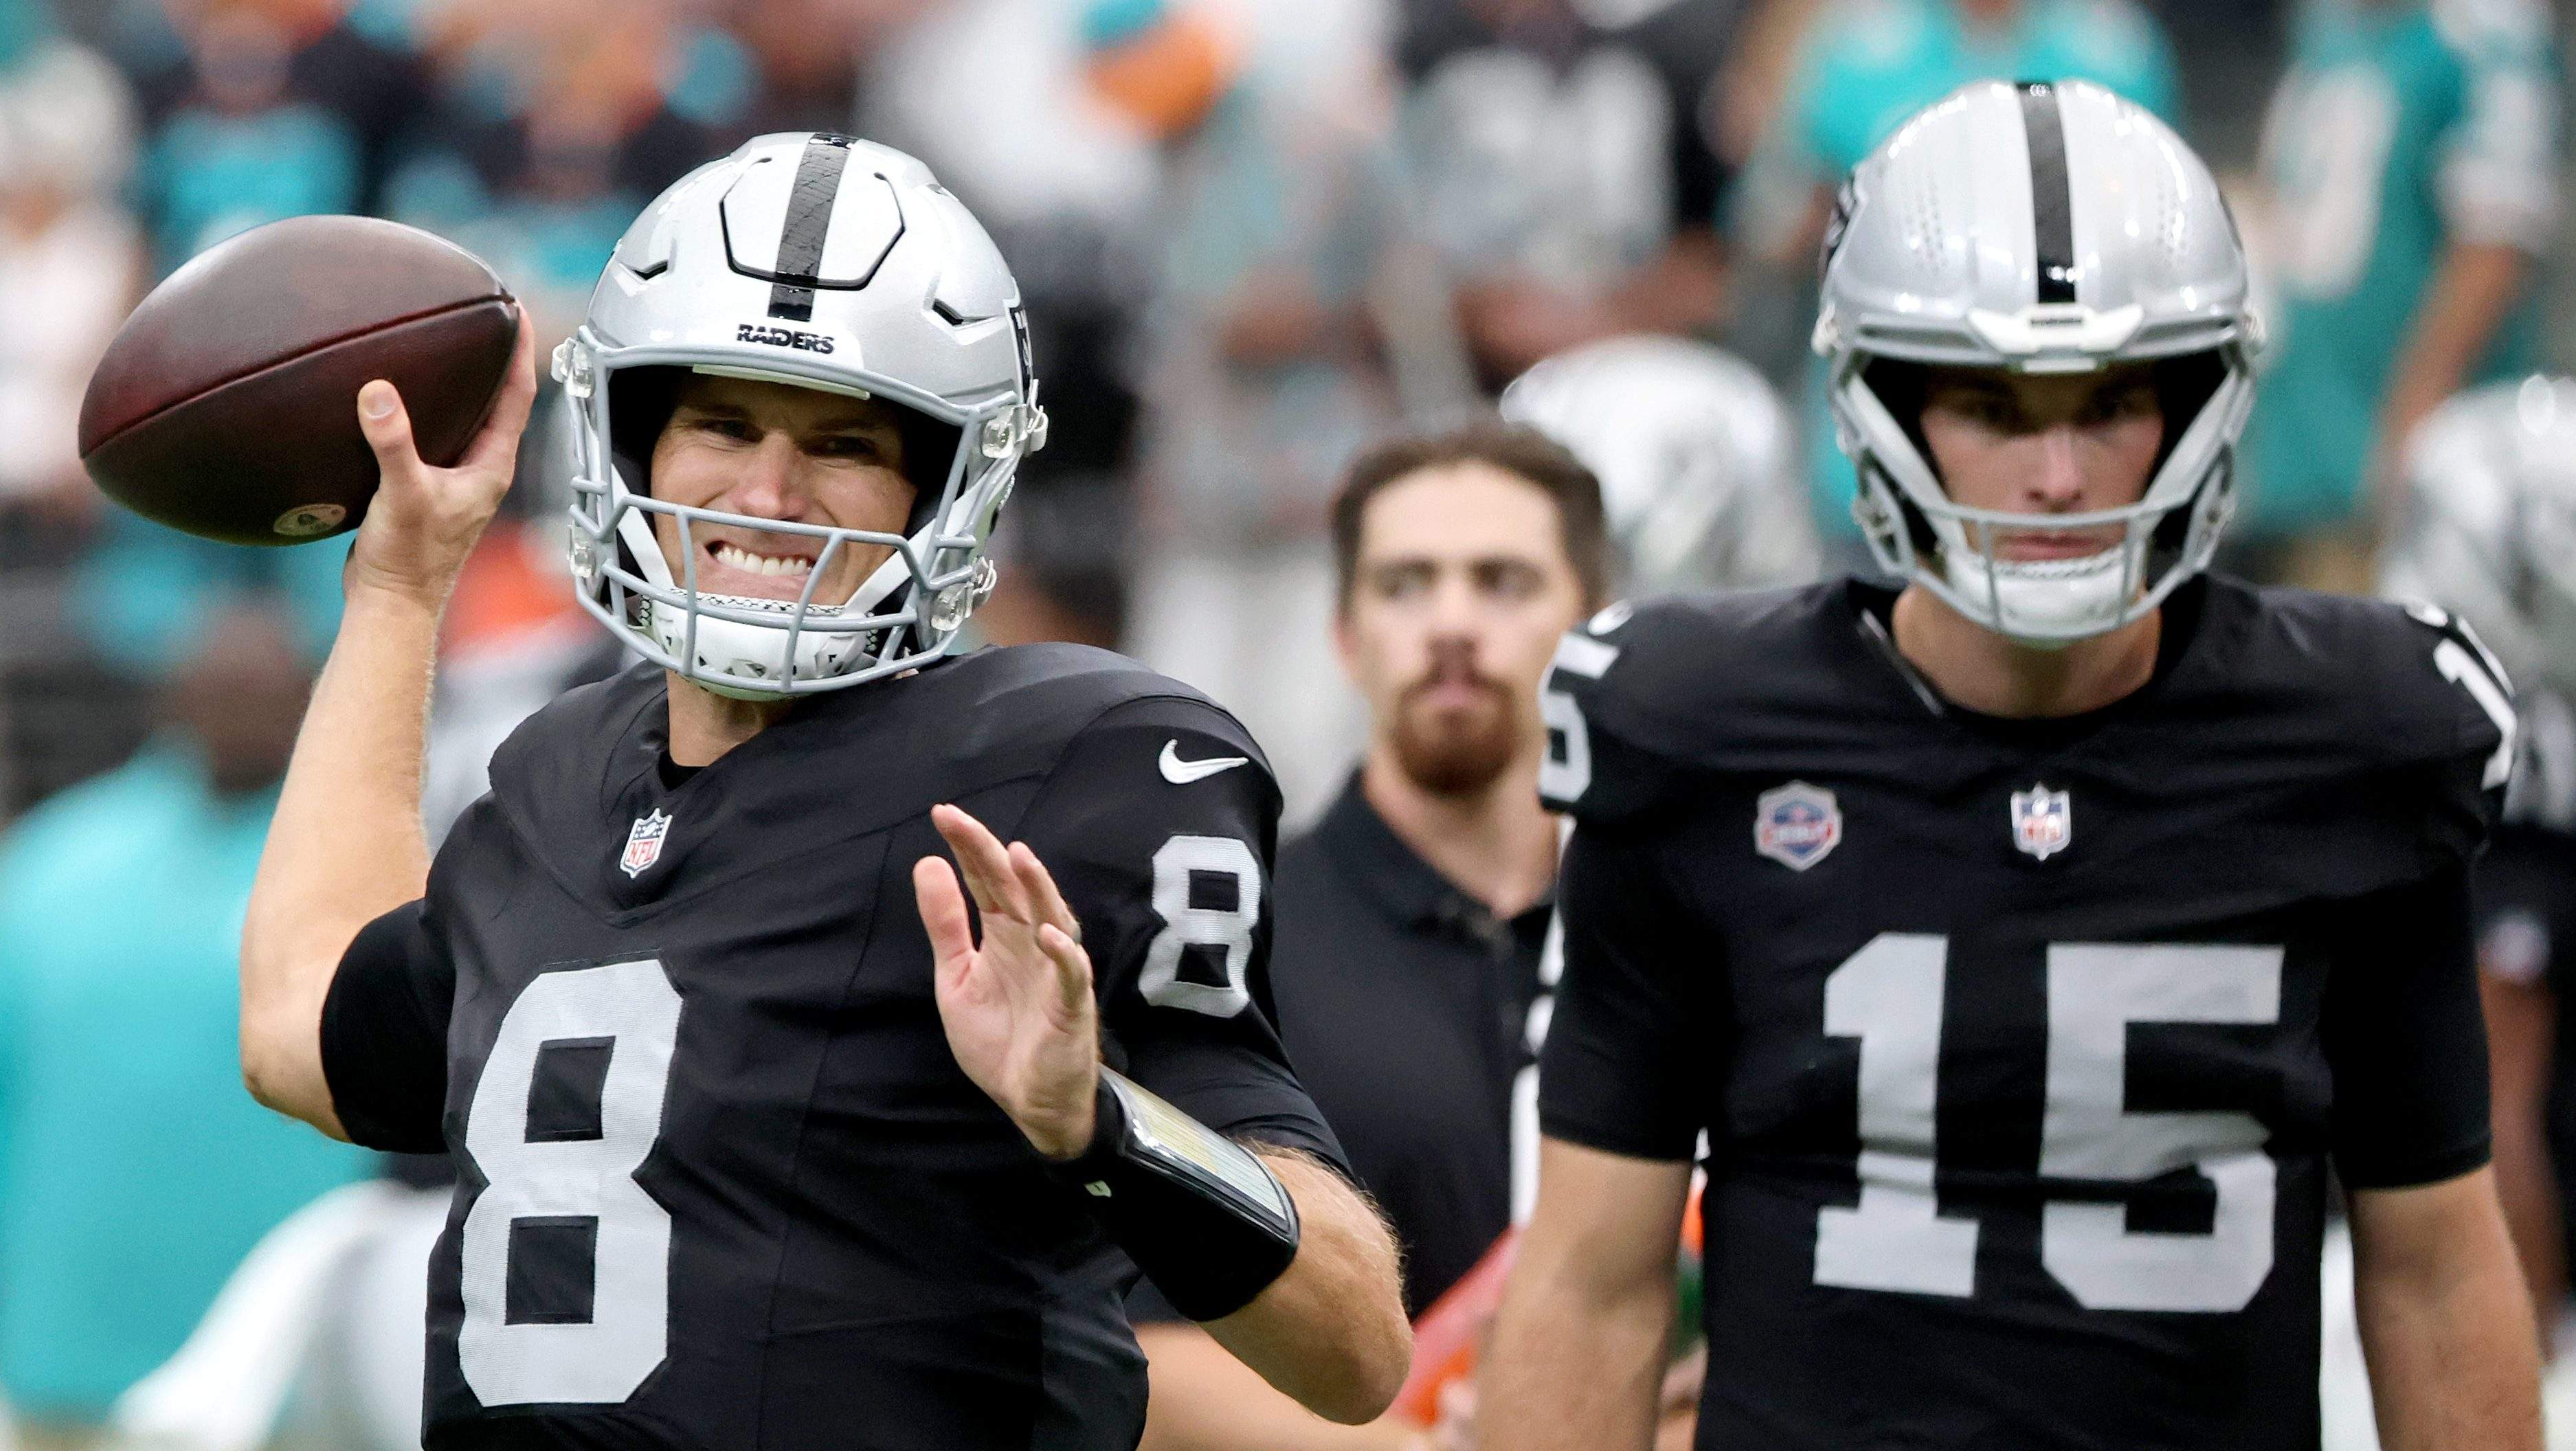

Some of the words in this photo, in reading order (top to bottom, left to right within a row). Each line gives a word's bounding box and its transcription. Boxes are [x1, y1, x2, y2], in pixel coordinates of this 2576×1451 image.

[737, 324, 834, 354] RAIDERS
[2433, 617, 2518, 790] 1
[625, 841, 656, 864] NFL
[1138, 835, 1262, 1018] 8
[458, 959, 684, 1408] 8
[1813, 932, 2285, 1312] 15
